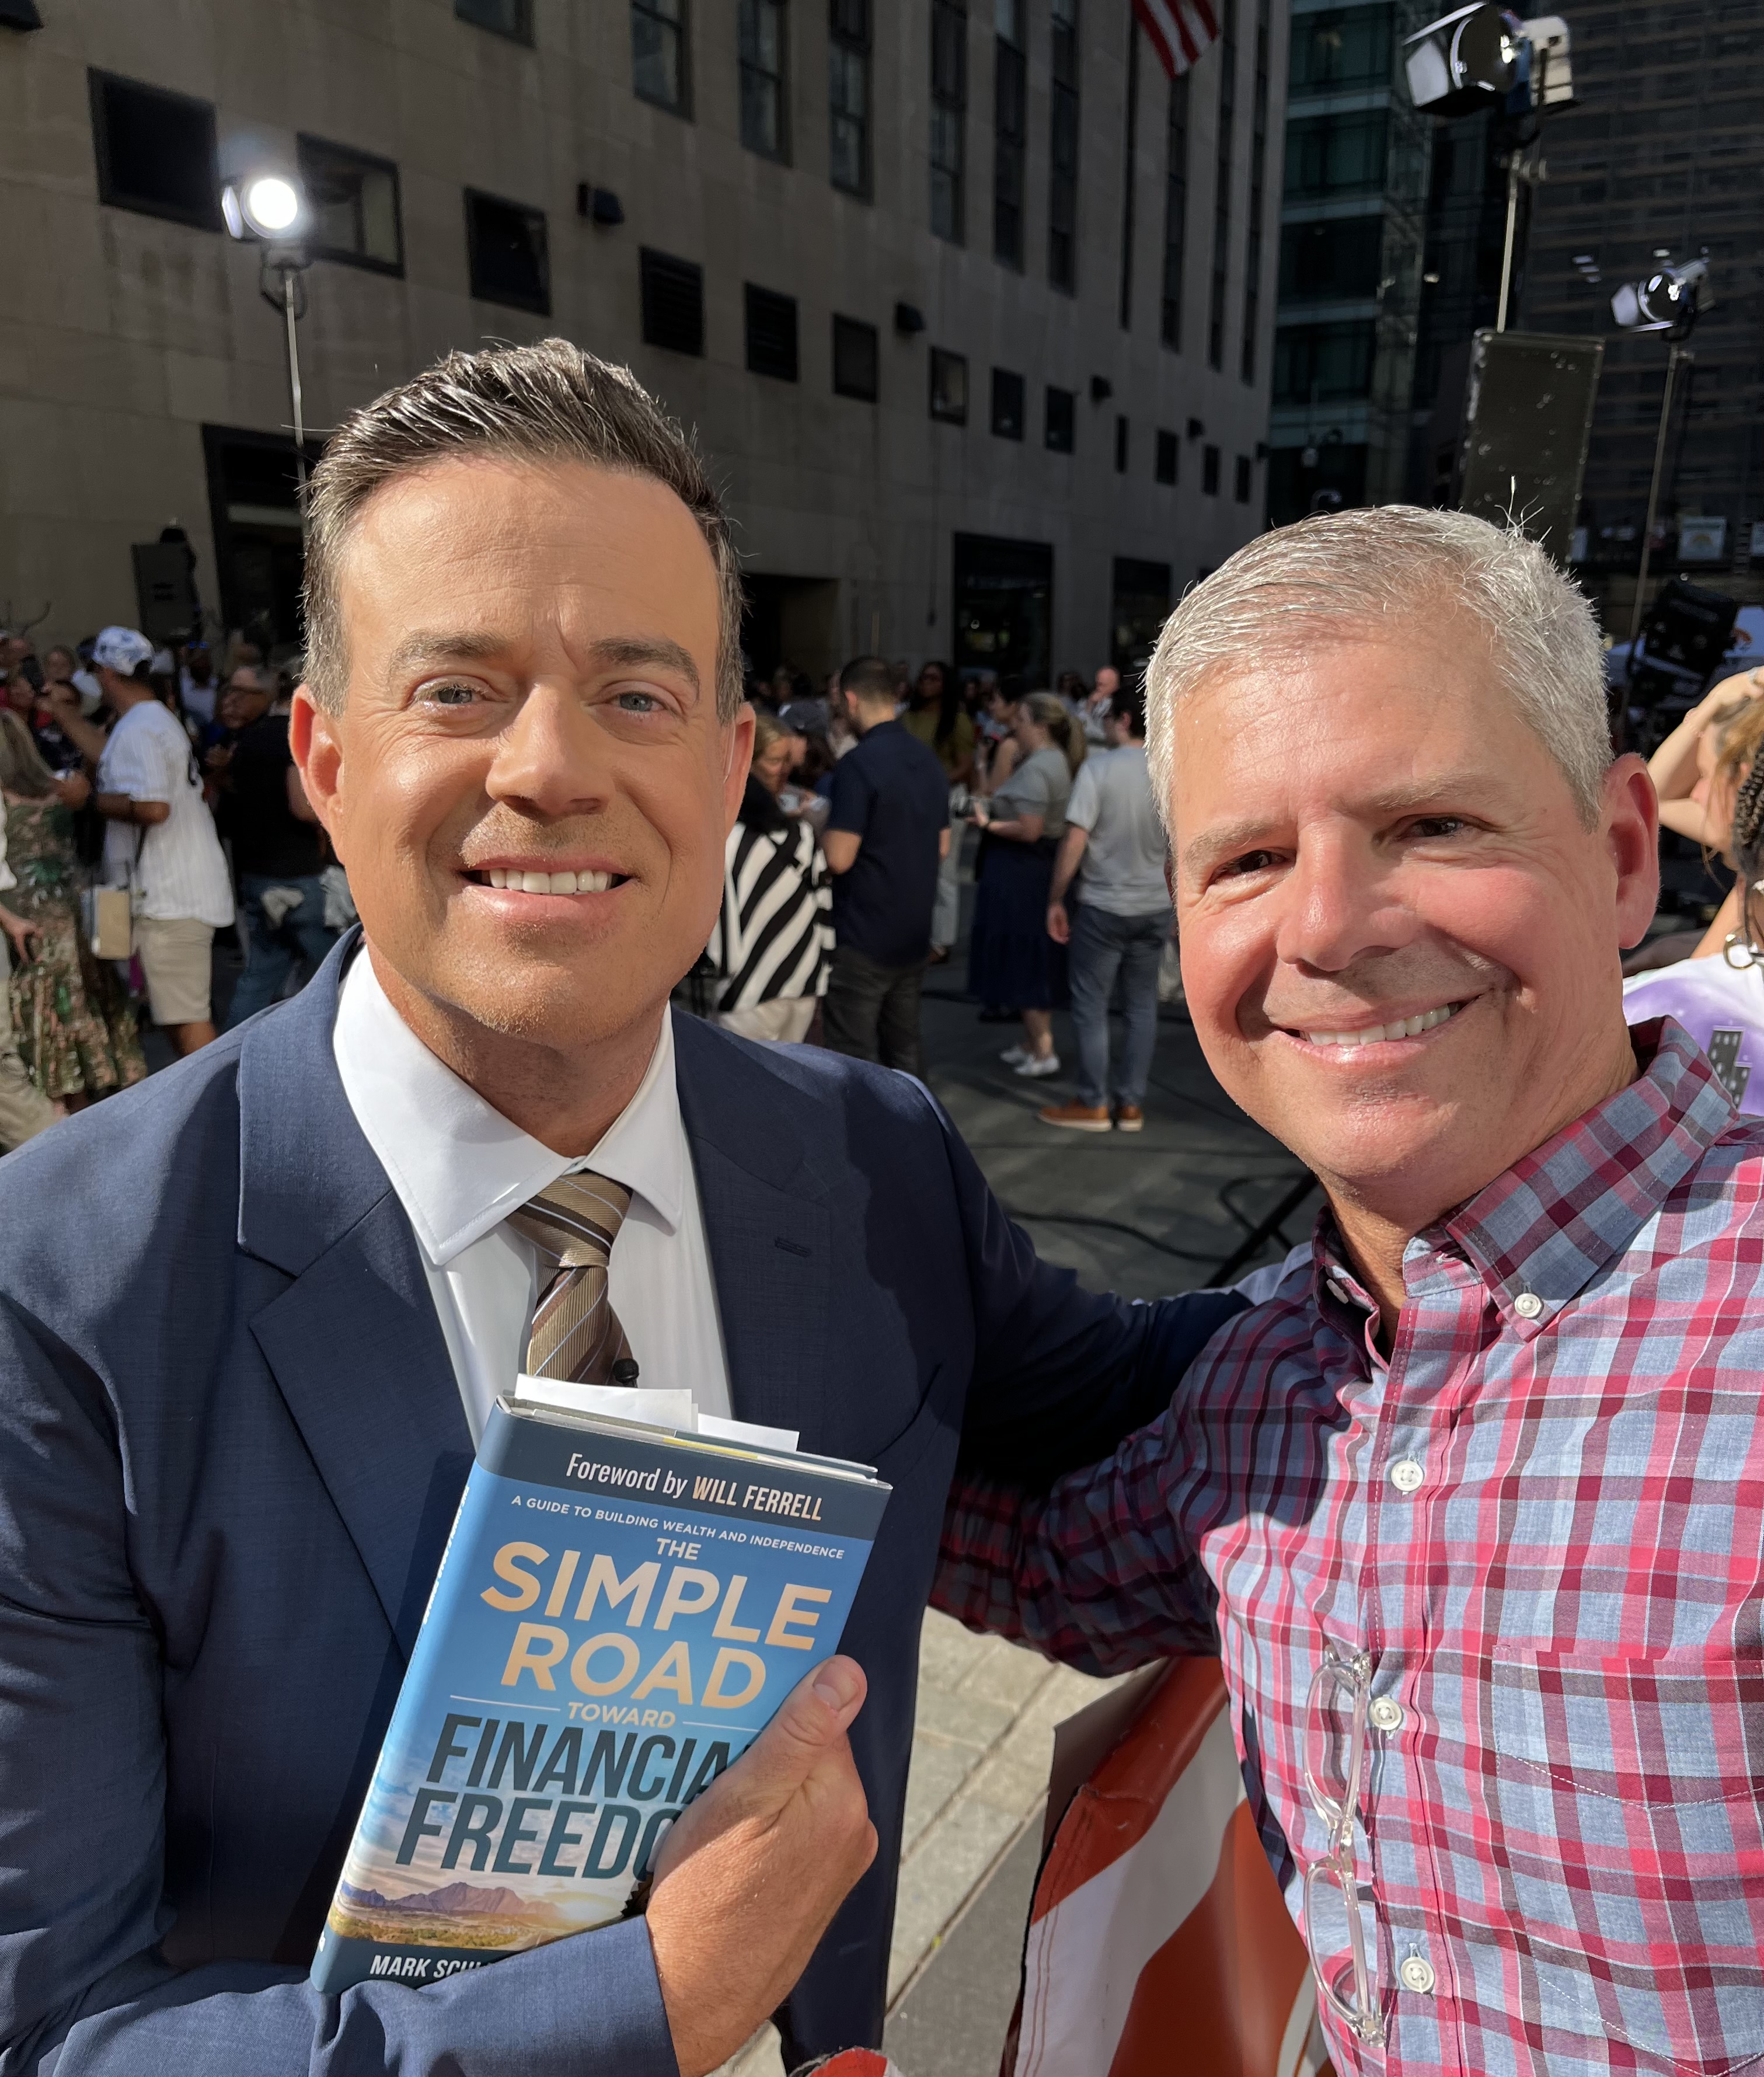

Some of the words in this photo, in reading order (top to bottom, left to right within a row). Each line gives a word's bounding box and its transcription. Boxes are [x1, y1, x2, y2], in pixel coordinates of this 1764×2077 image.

[566, 1452, 661, 1491] Foreword
[663, 1470, 688, 1498] by
[692, 1476, 737, 1506] WILL
[742, 1485, 822, 1521] FERRELL
[511, 1496, 521, 1506] A
[527, 1498, 570, 1514] GUIDE
[574, 1506, 591, 1517] TO
[595, 1510, 658, 1528] BUILDING
[663, 1520, 716, 1538] WEALTH
[719, 1531, 747, 1542] AND
[749, 1535, 845, 1559] INDEPENDENCE
[657, 1538, 701, 1560] THE
[480, 1542, 832, 1650] SIMPLE
[501, 1622, 766, 1709] ROAD
[567, 1702, 676, 1728] TOWARD
[426, 1713, 751, 1804] FINANCIA
[369, 1954, 431, 1978] MARK
